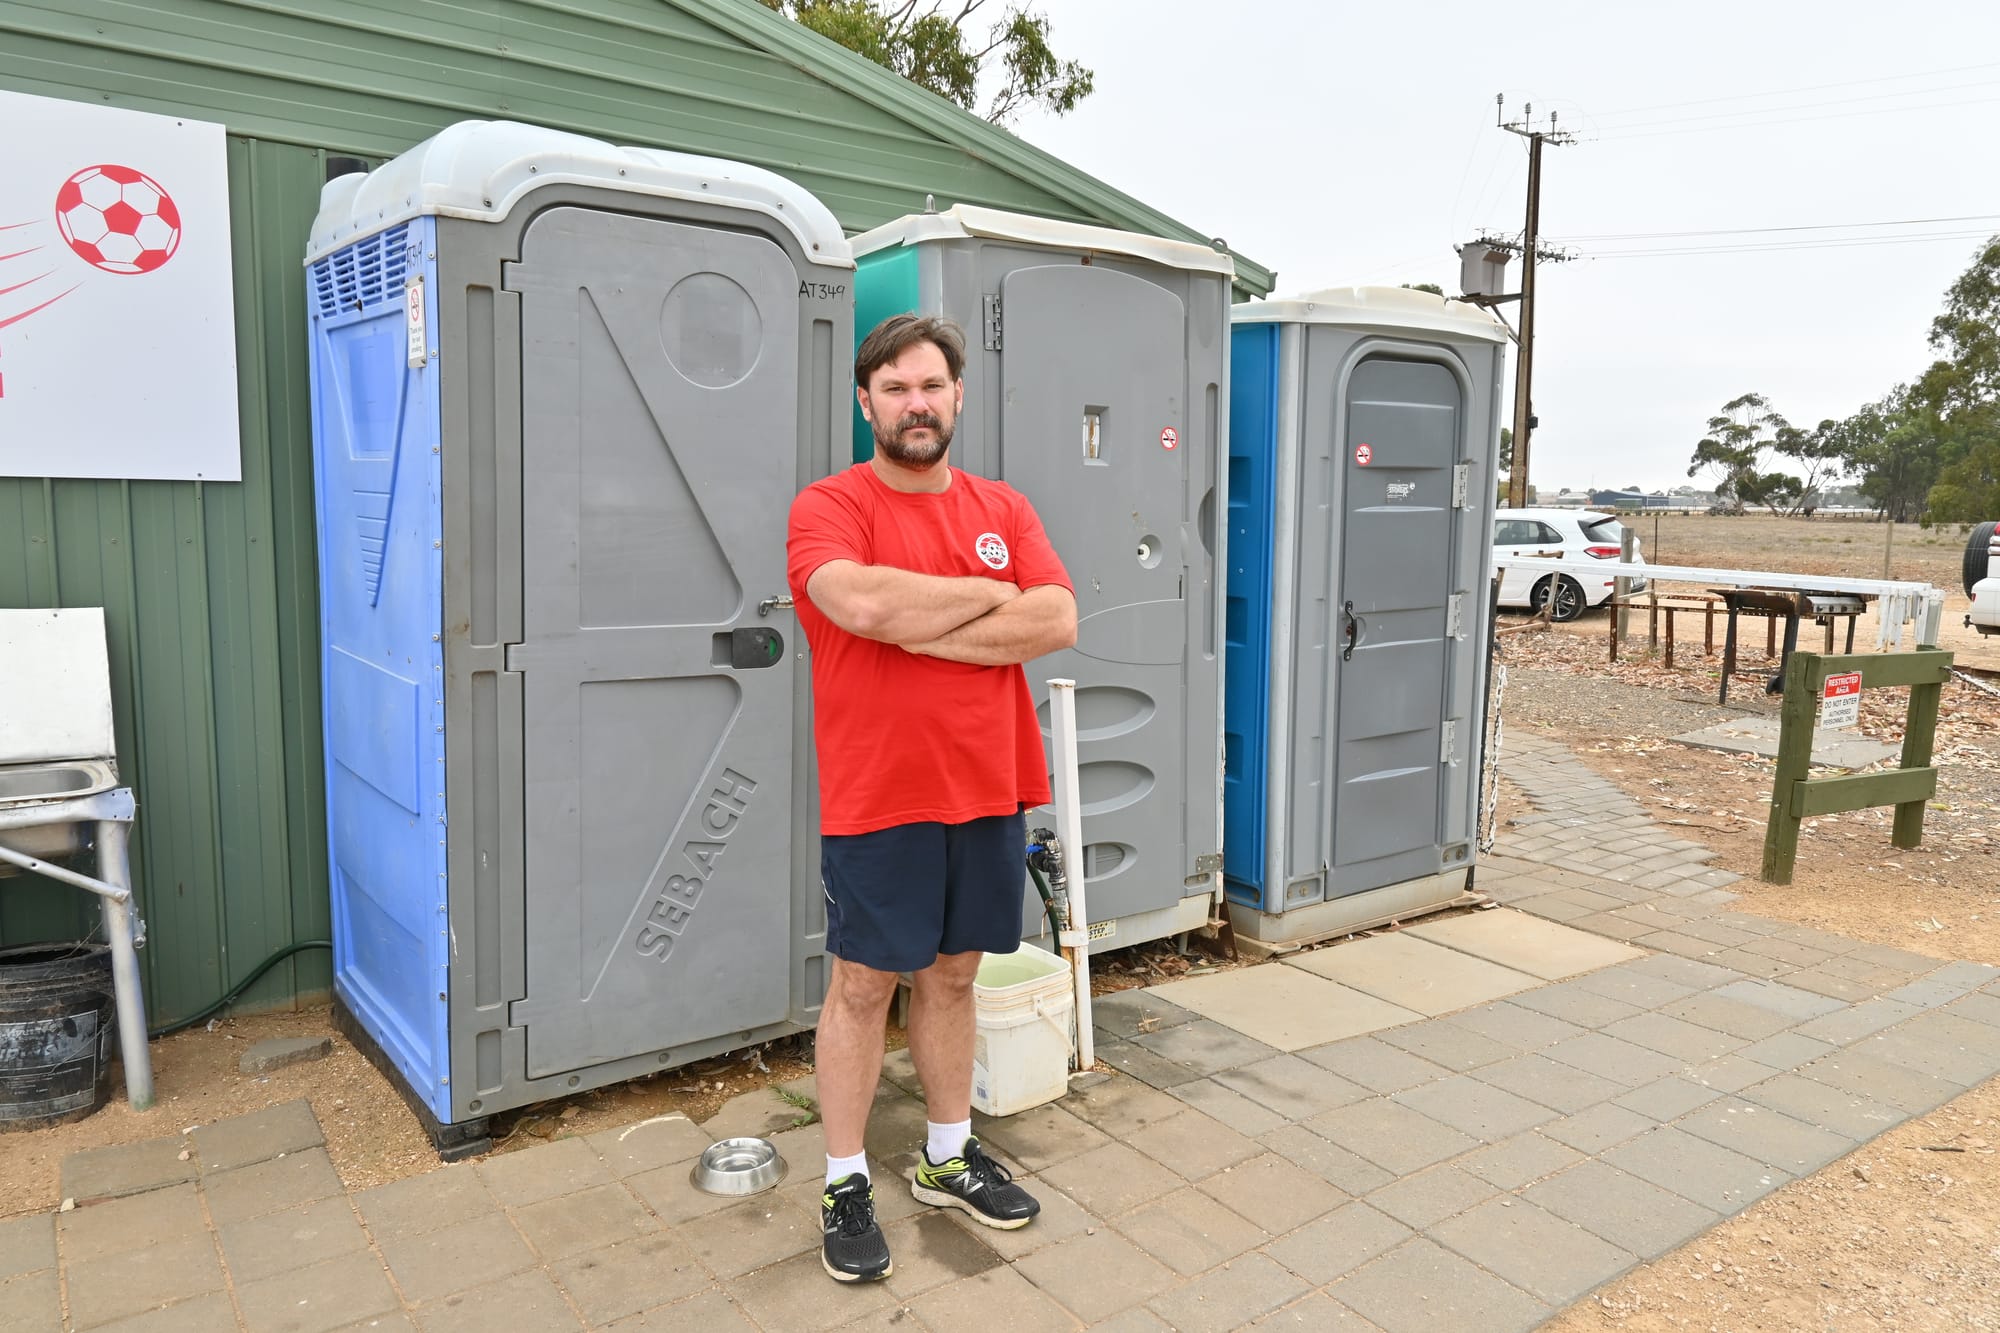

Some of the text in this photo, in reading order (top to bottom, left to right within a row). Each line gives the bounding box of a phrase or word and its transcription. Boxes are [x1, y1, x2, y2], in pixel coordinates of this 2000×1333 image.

[798, 279, 846, 300] AT349
[1828, 676, 1859, 687] RESTRICTED
[1836, 685, 1850, 694] AREA
[1824, 697, 1858, 709] DO NOT ENTER
[1829, 708, 1852, 717] AUTHORISED
[1823, 717, 1845, 726] PERSONNEL
[635, 767, 758, 964] SEBACH
